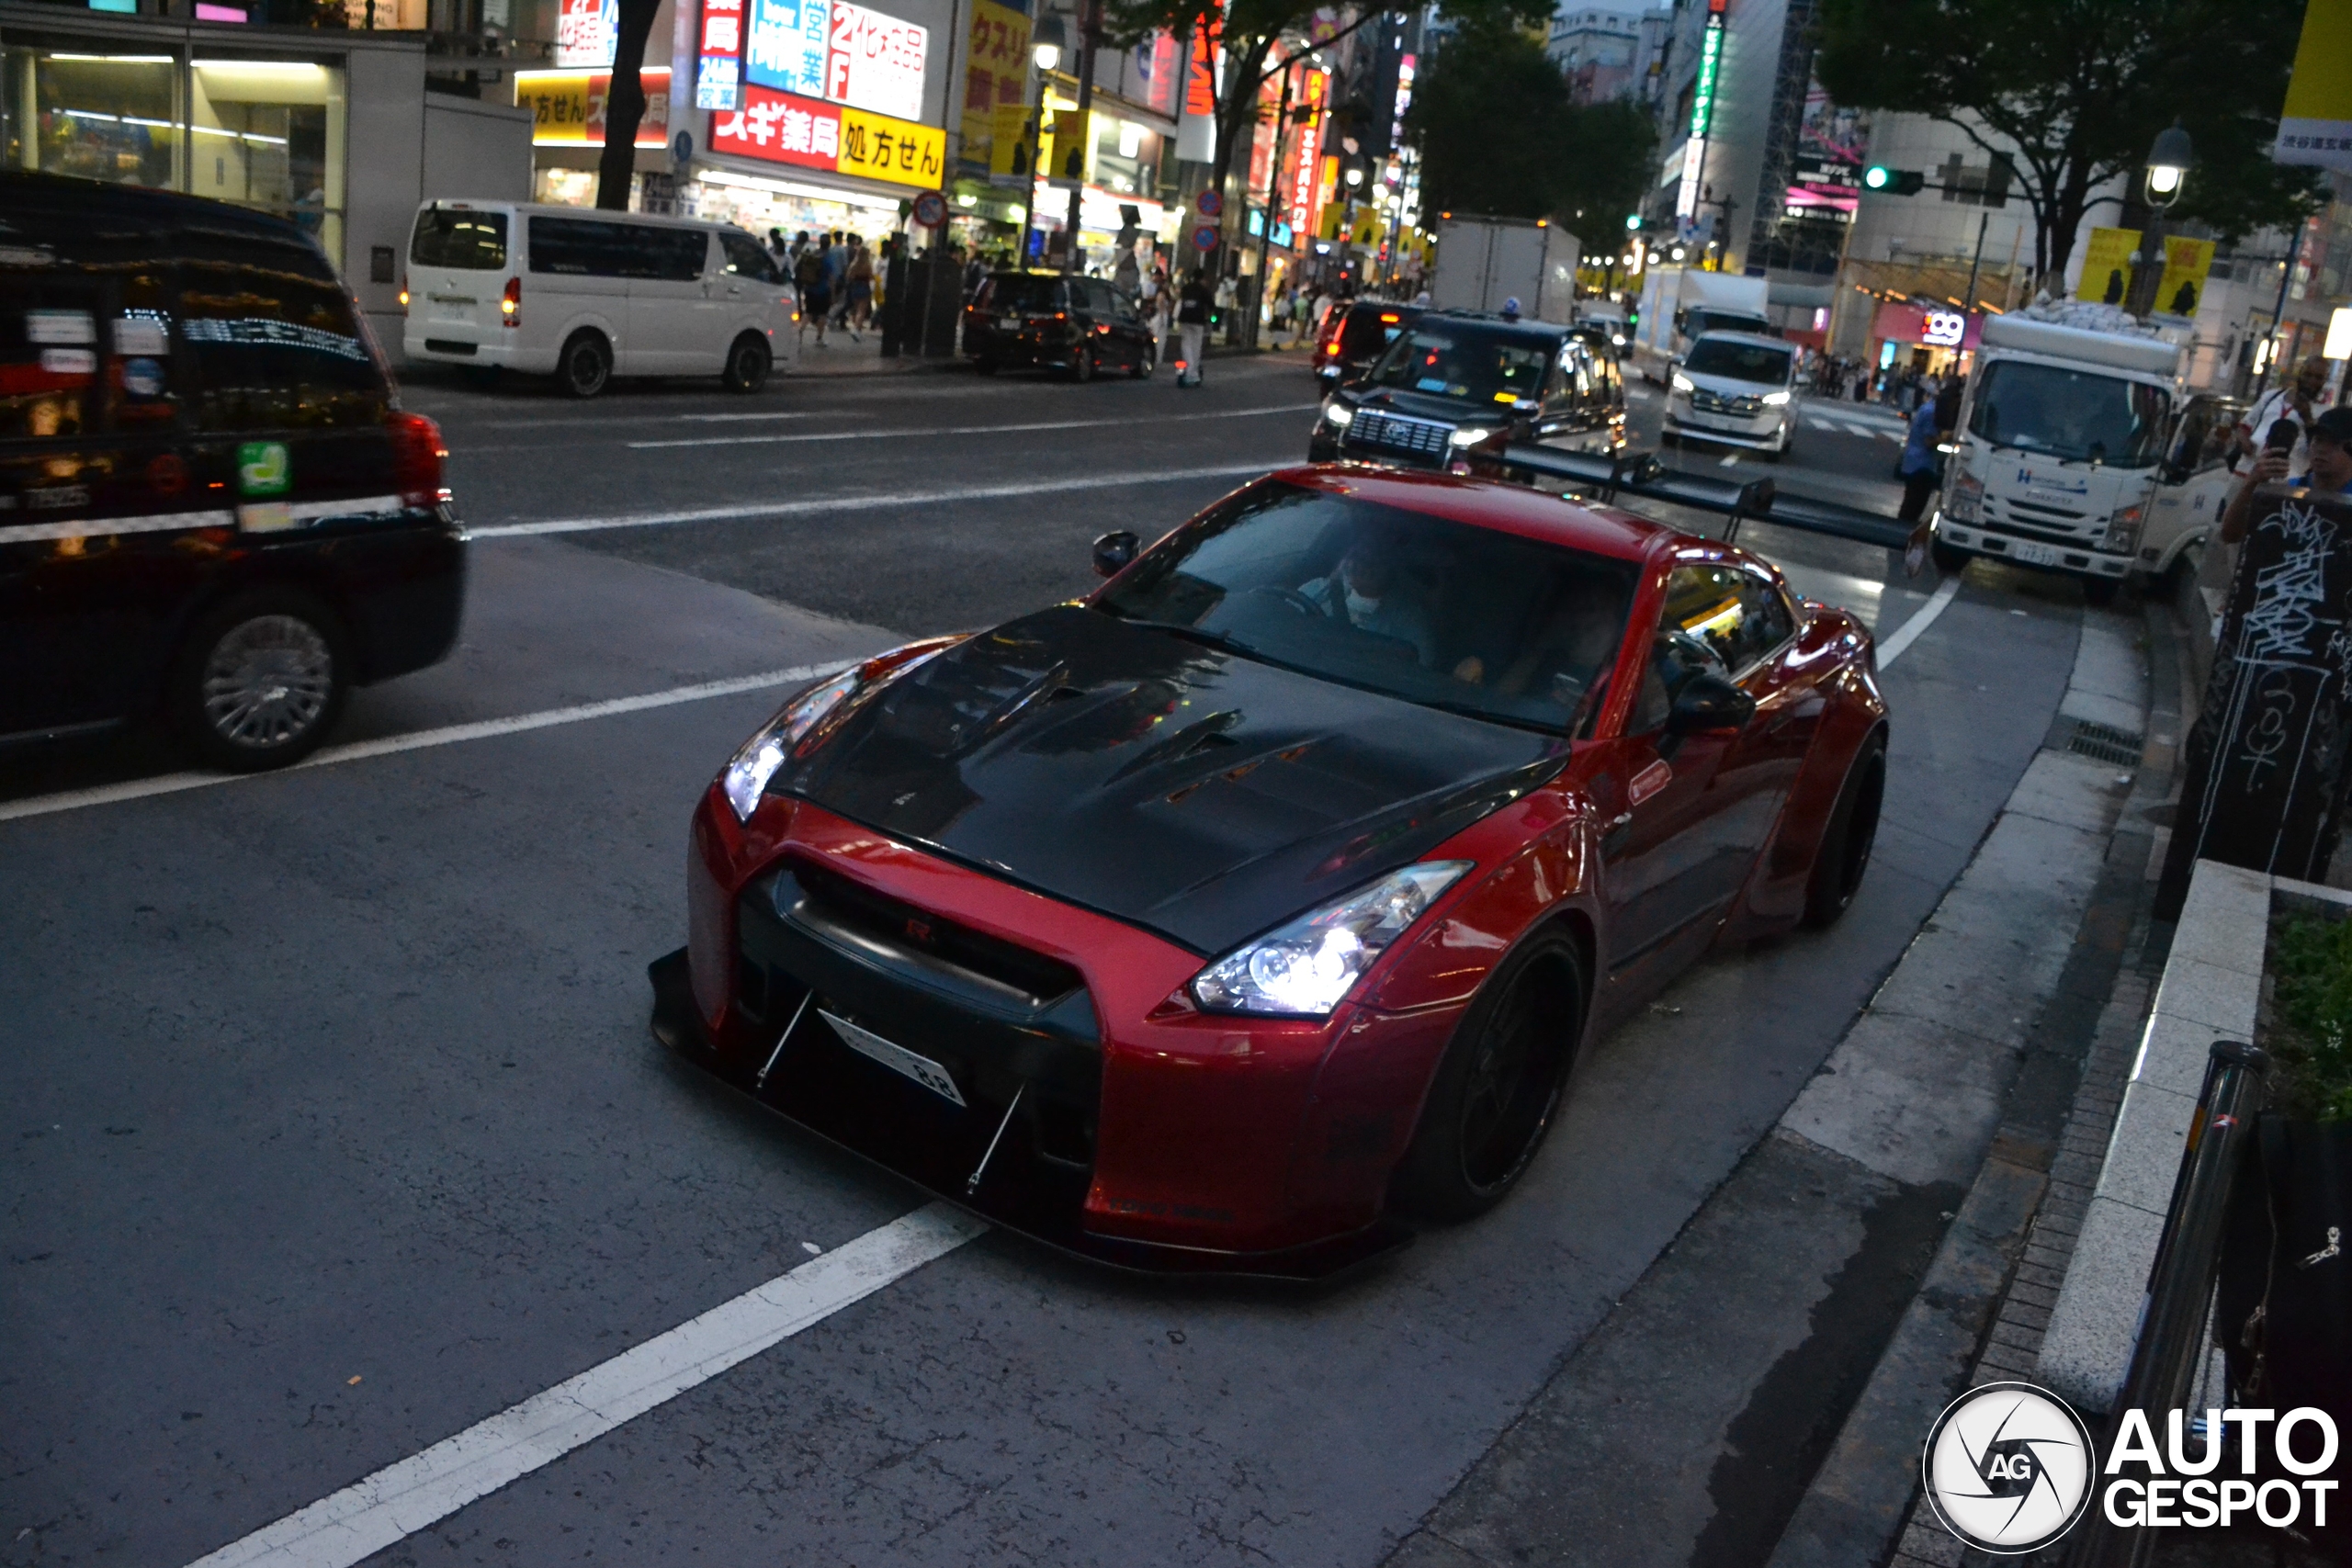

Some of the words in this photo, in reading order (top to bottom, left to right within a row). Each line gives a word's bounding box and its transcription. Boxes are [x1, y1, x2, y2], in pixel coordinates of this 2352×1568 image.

[800, 0, 827, 90] 営業
[715, 102, 840, 159] スギ薬局
[843, 120, 941, 175] 処方せん
